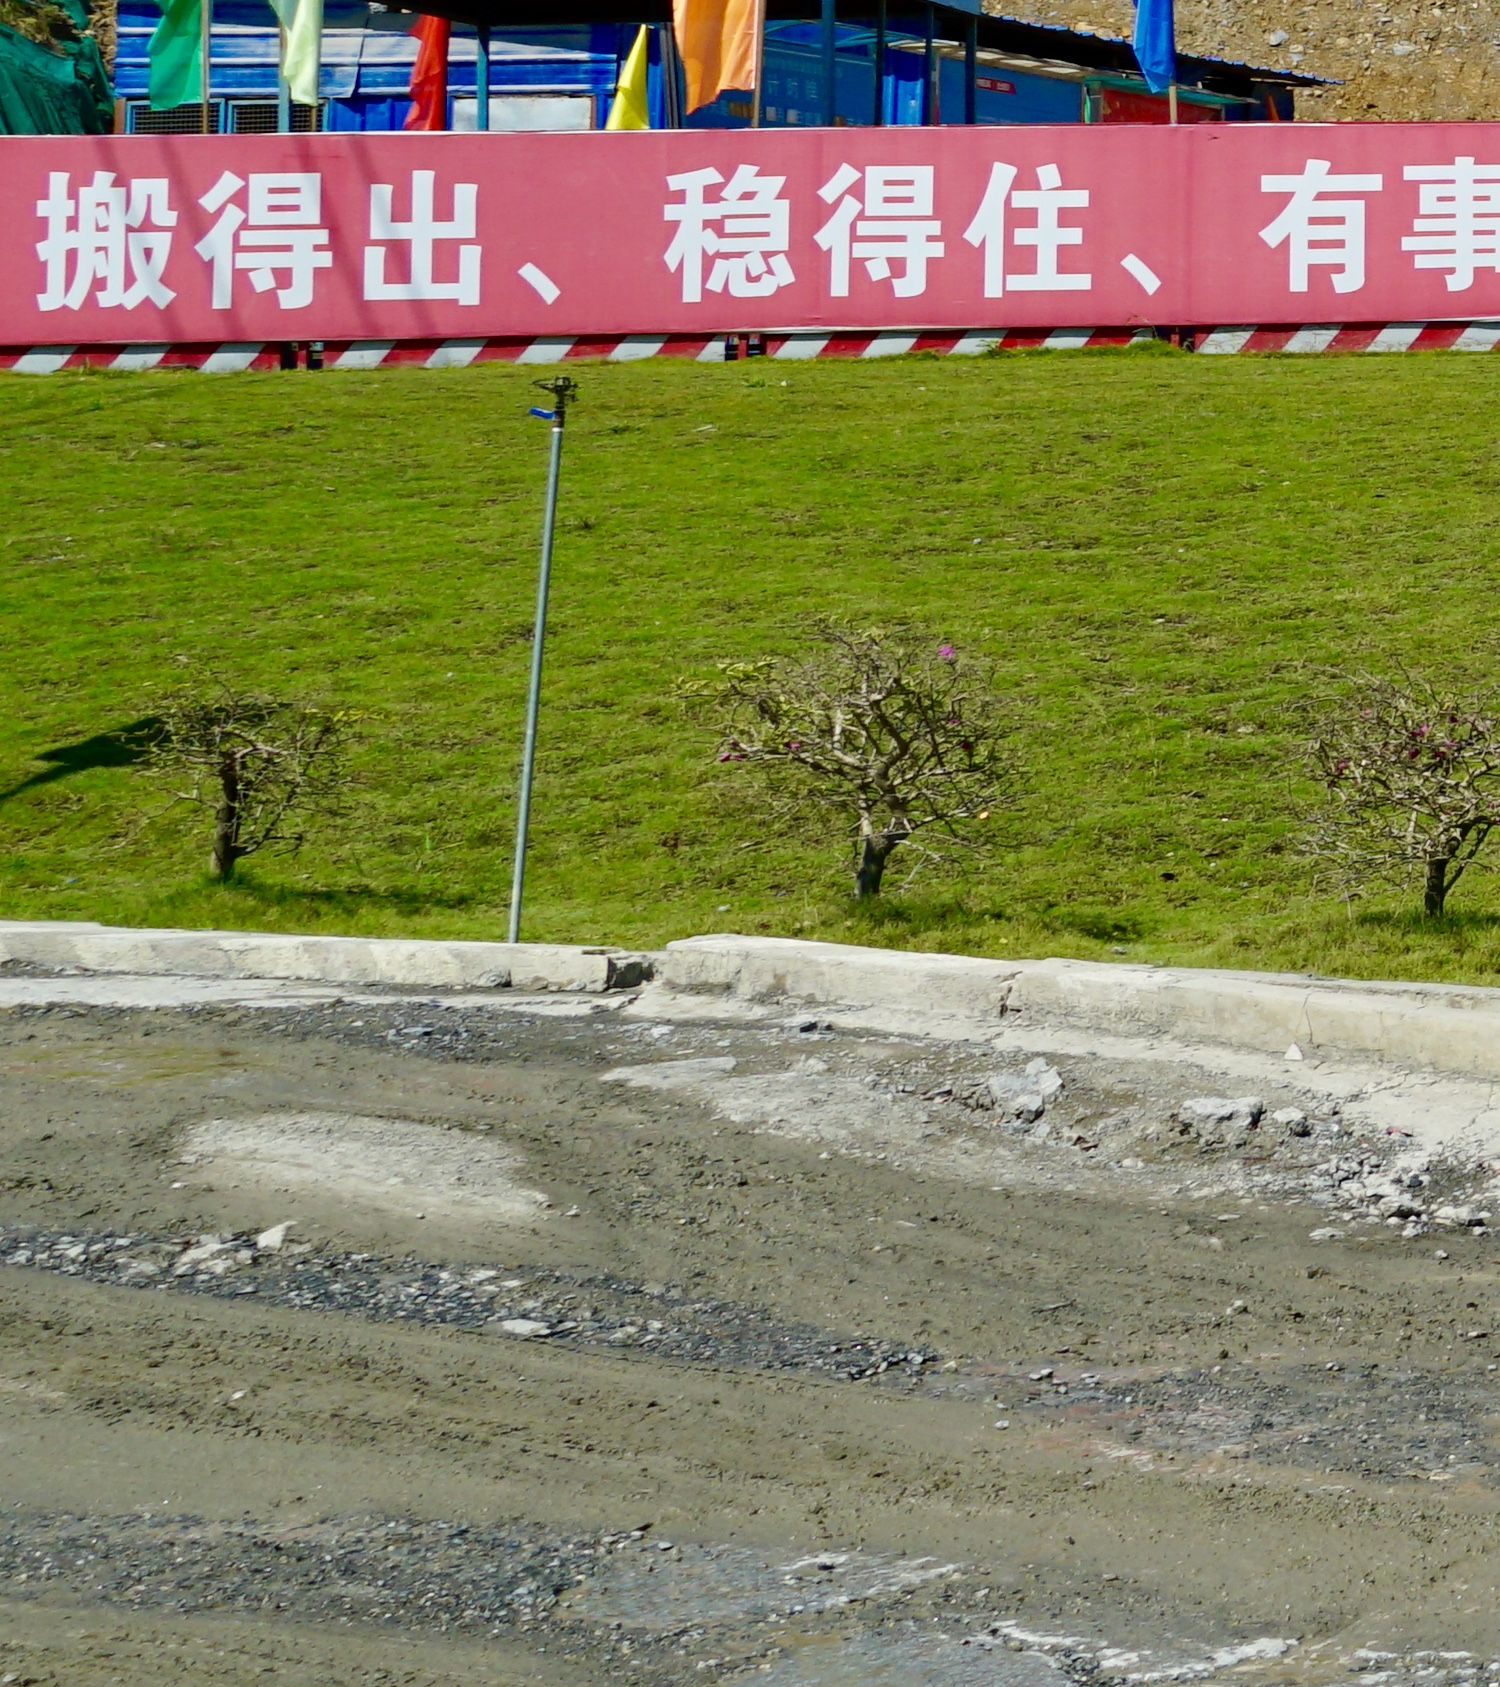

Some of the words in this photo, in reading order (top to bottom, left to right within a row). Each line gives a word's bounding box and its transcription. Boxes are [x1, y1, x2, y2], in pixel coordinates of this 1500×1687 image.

[36, 169, 562, 312] 搬得出、
[663, 162, 1161, 303] 稳得住、
